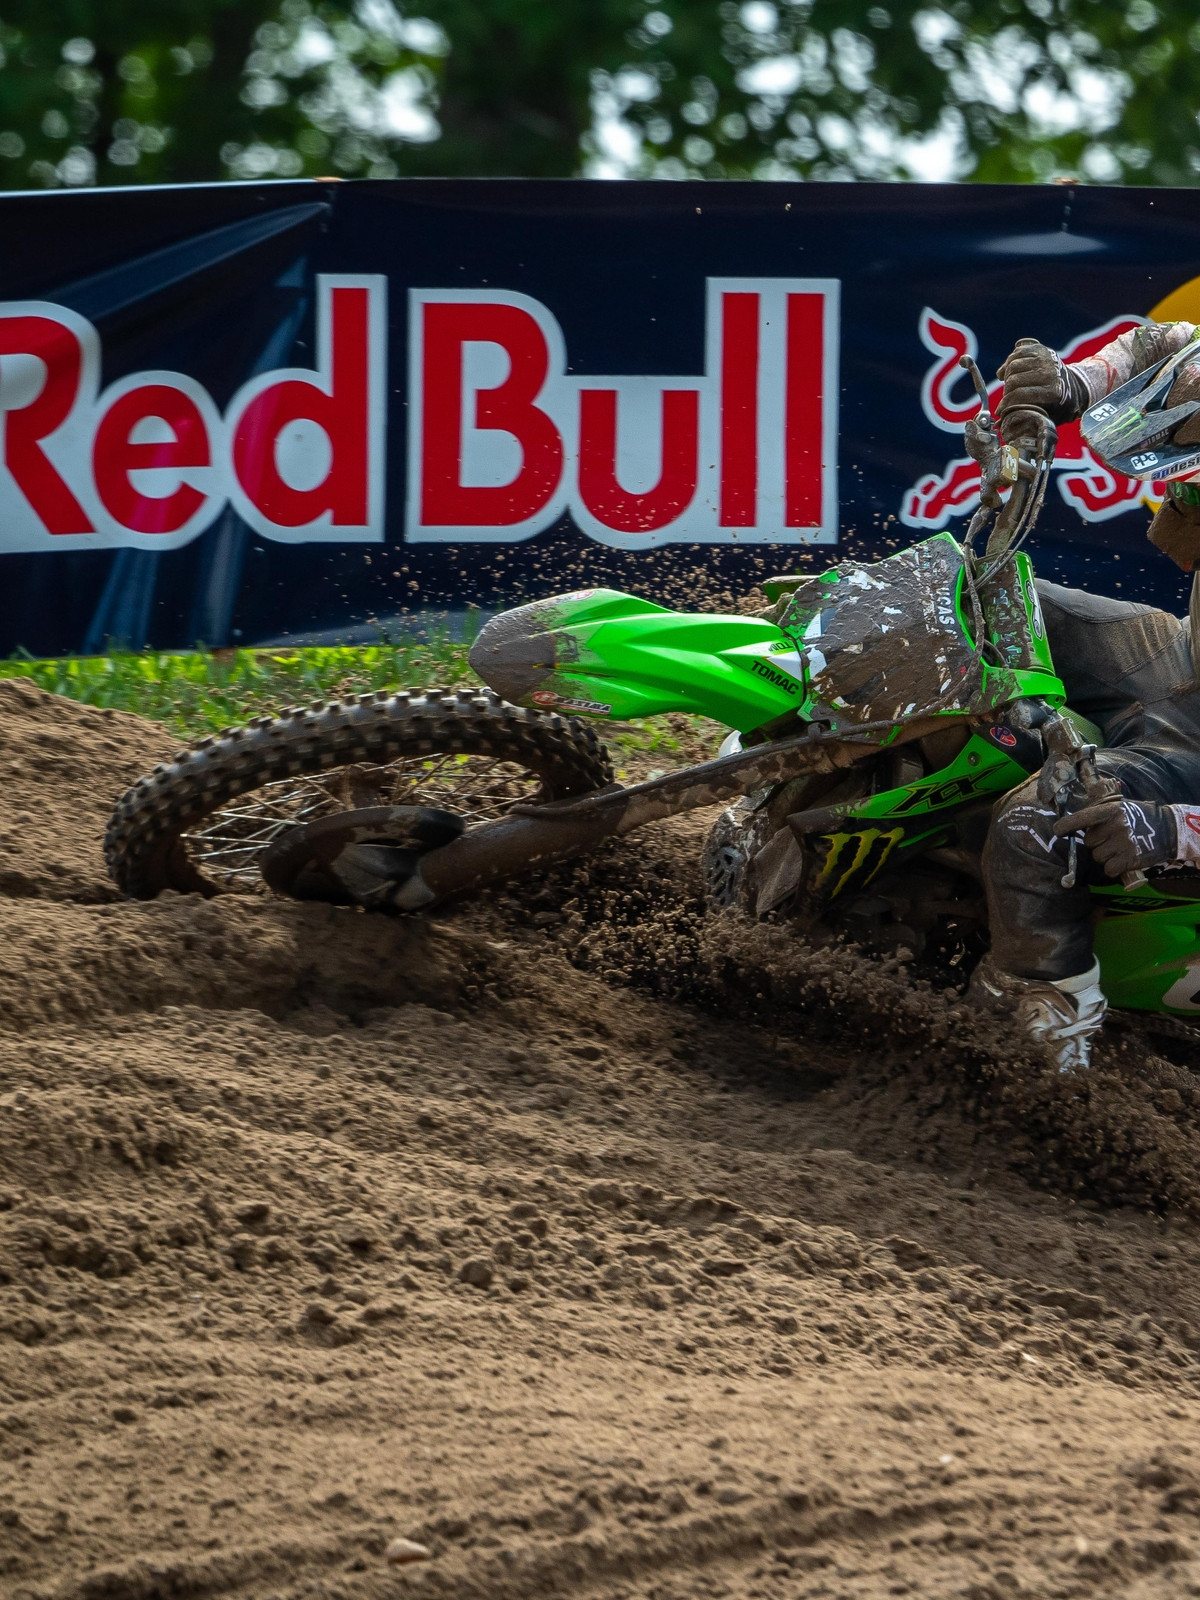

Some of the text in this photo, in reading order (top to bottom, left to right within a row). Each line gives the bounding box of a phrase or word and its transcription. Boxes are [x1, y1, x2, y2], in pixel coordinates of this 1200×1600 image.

[0, 286, 827, 536] Red Bull
[1132, 454, 1158, 468] PPG
[751, 660, 799, 695] TOMAC
